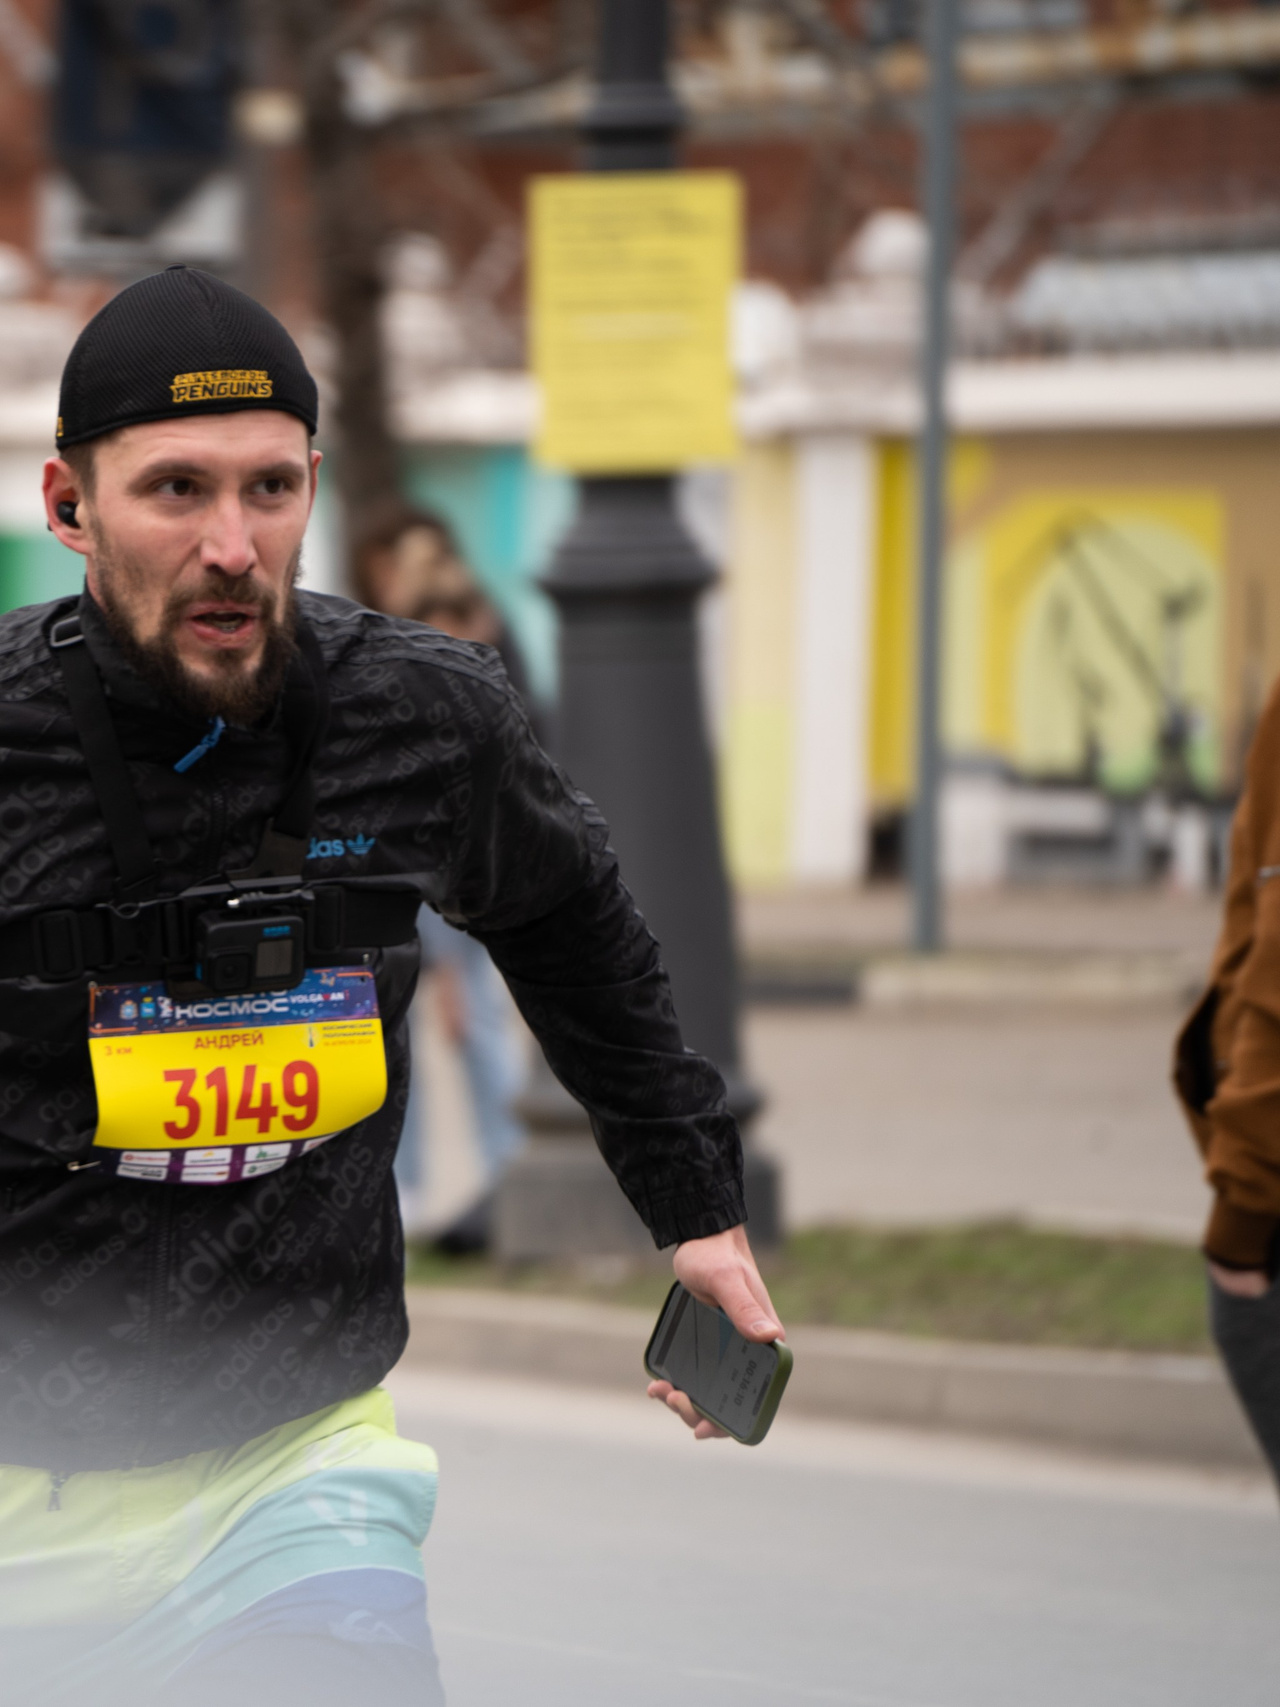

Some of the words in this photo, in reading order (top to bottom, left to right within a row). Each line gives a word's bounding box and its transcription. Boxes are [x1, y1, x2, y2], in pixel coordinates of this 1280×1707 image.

[170, 380, 273, 403] PENGUINS
[175, 997, 289, 1019] КОСМОС
[194, 1029, 264, 1050] АНДРЕЙ
[163, 1060, 319, 1140] 3149
